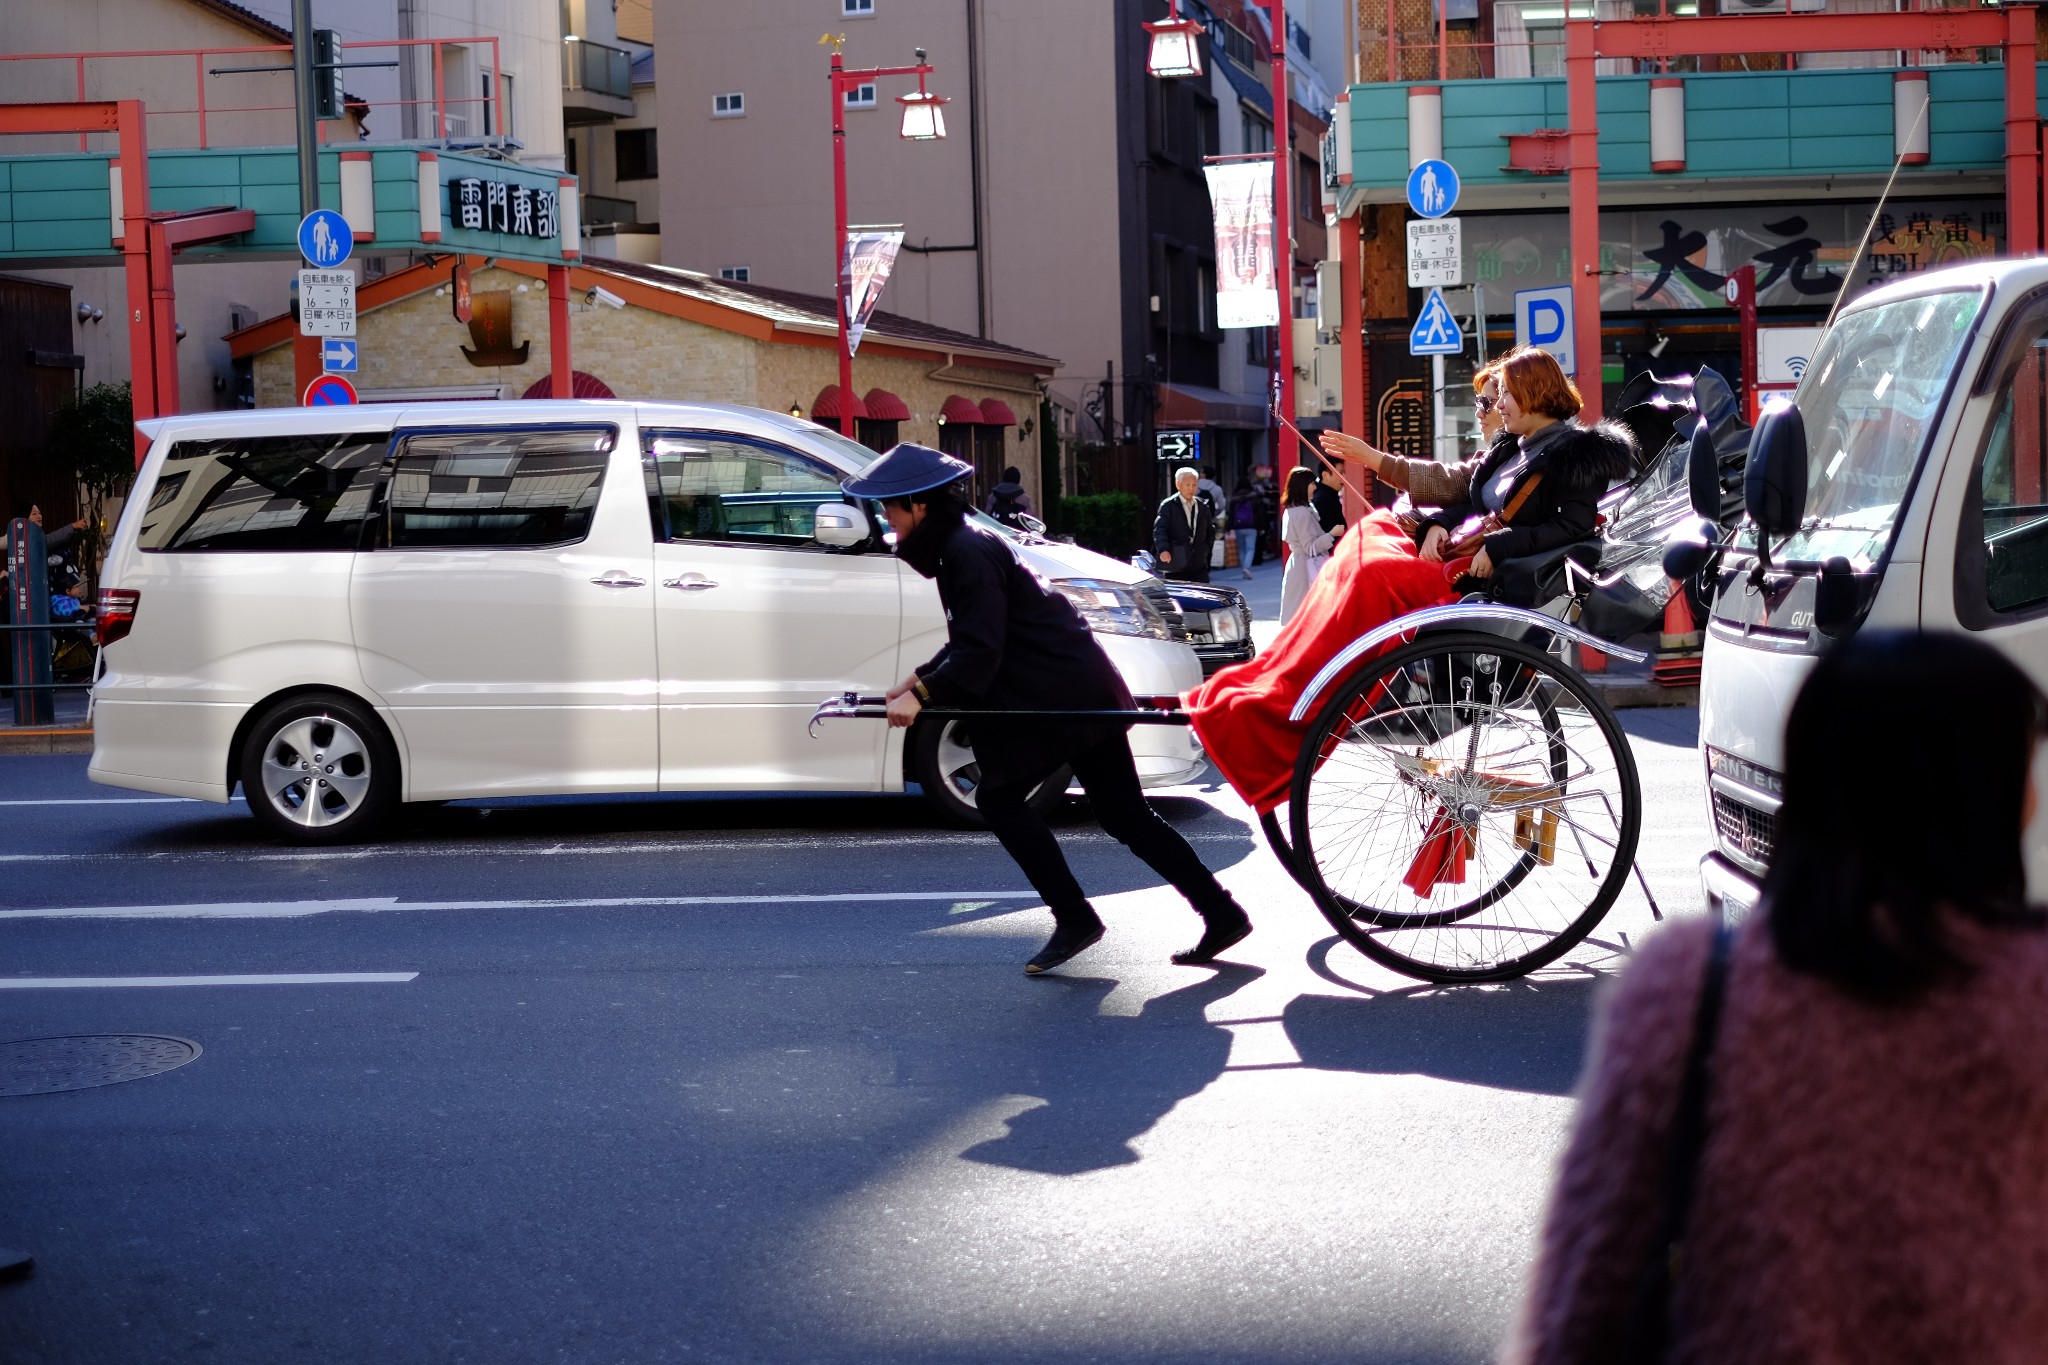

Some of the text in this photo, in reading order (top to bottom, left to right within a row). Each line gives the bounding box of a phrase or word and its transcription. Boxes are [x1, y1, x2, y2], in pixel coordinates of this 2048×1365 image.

[461, 178, 558, 237] 雷門東部
[1410, 223, 1457, 235] 自転車を除く
[1413, 237, 1419, 247] 7
[1448, 234, 1454, 245] 9
[1413, 249, 1422, 258] 16
[1445, 246, 1454, 256] 19
[1635, 216, 1843, 301] 大元
[1867, 252, 1927, 274] TEL
[302, 274, 352, 284] 自転車を除く
[1414, 272, 1420, 282] 9
[1445, 270, 1455, 280] 17
[306, 285, 313, 296] 7
[343, 286, 349, 296] 9
[306, 297, 316, 308] 16
[340, 298, 349, 308] 19
[307, 321, 314, 331] 9
[340, 321, 350, 331] 17
[1528, 298, 1565, 347] P
